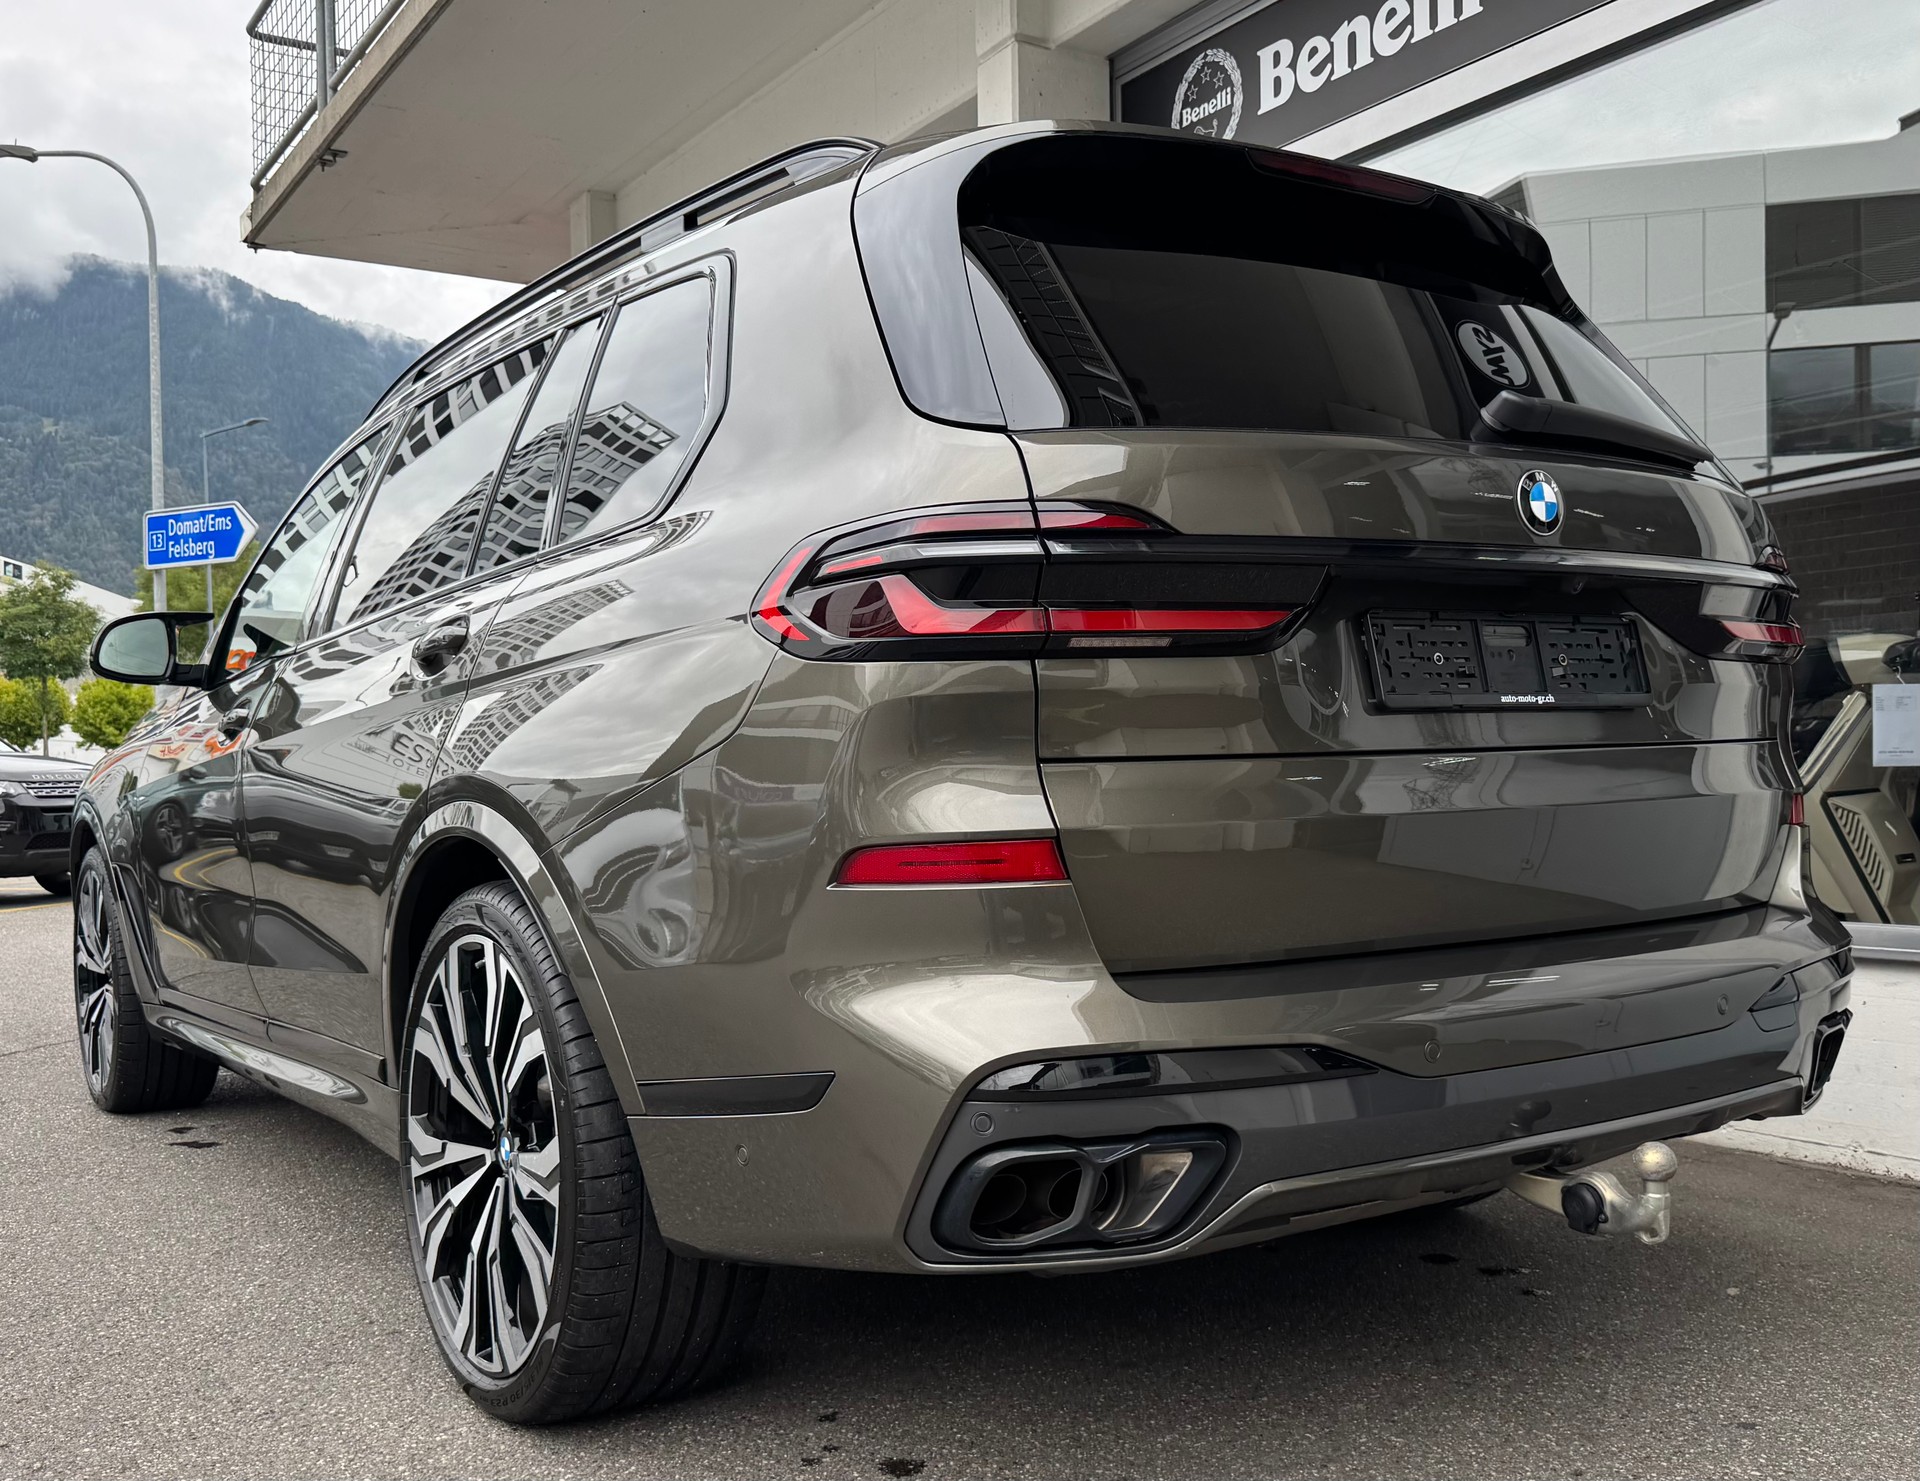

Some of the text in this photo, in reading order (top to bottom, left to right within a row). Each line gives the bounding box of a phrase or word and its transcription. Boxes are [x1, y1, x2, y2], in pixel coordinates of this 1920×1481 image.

[1181, 86, 1233, 129] Benelli
[1521, 472, 1559, 492] BMW
[168, 513, 232, 537] Domat/Ems
[151, 533, 164, 549] 13
[168, 537, 215, 559] Felsberg
[1500, 693, 1556, 705] auto-moto-gr.ch
